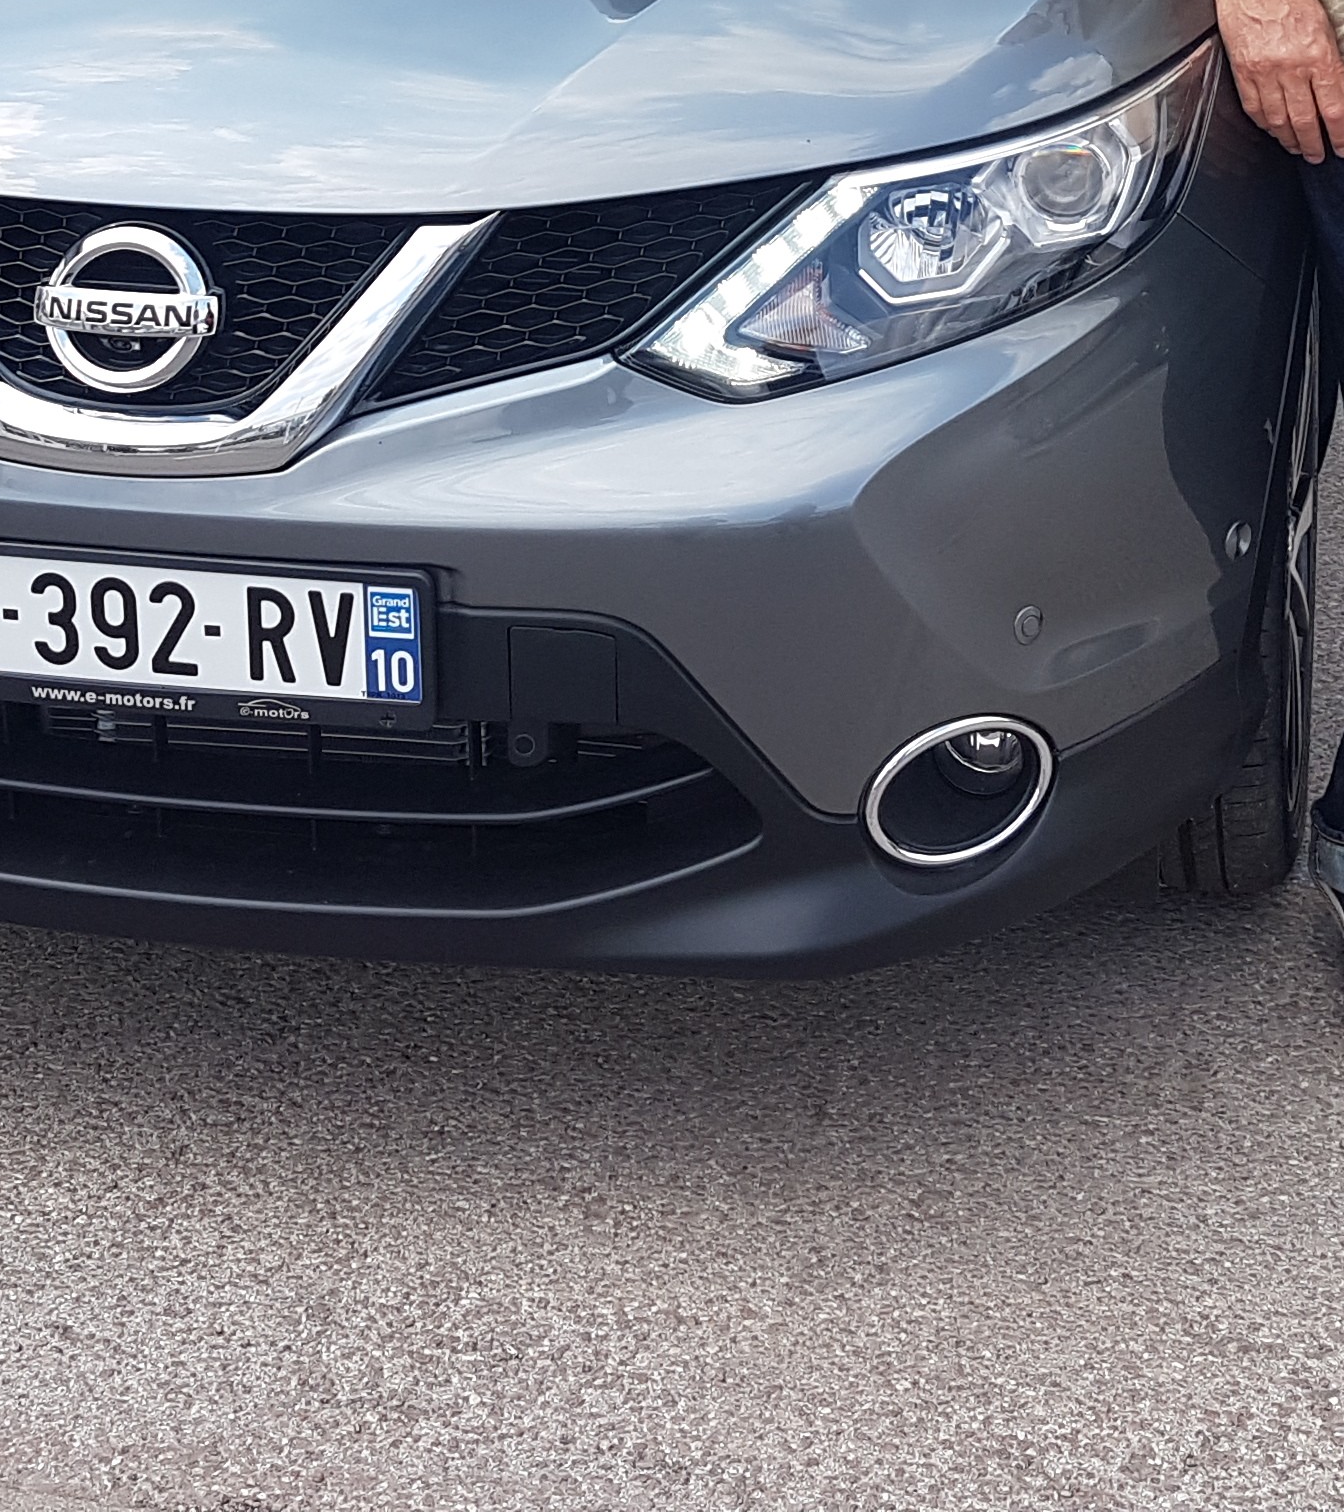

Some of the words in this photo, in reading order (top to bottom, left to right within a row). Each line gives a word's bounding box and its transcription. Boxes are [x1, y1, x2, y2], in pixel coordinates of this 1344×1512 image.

[49, 295, 193, 328] NISSAN
[371, 595, 410, 608] Grand
[372, 606, 410, 628] Est
[371, 648, 415, 694] 10
[31, 685, 196, 712] www.e-motors.fr
